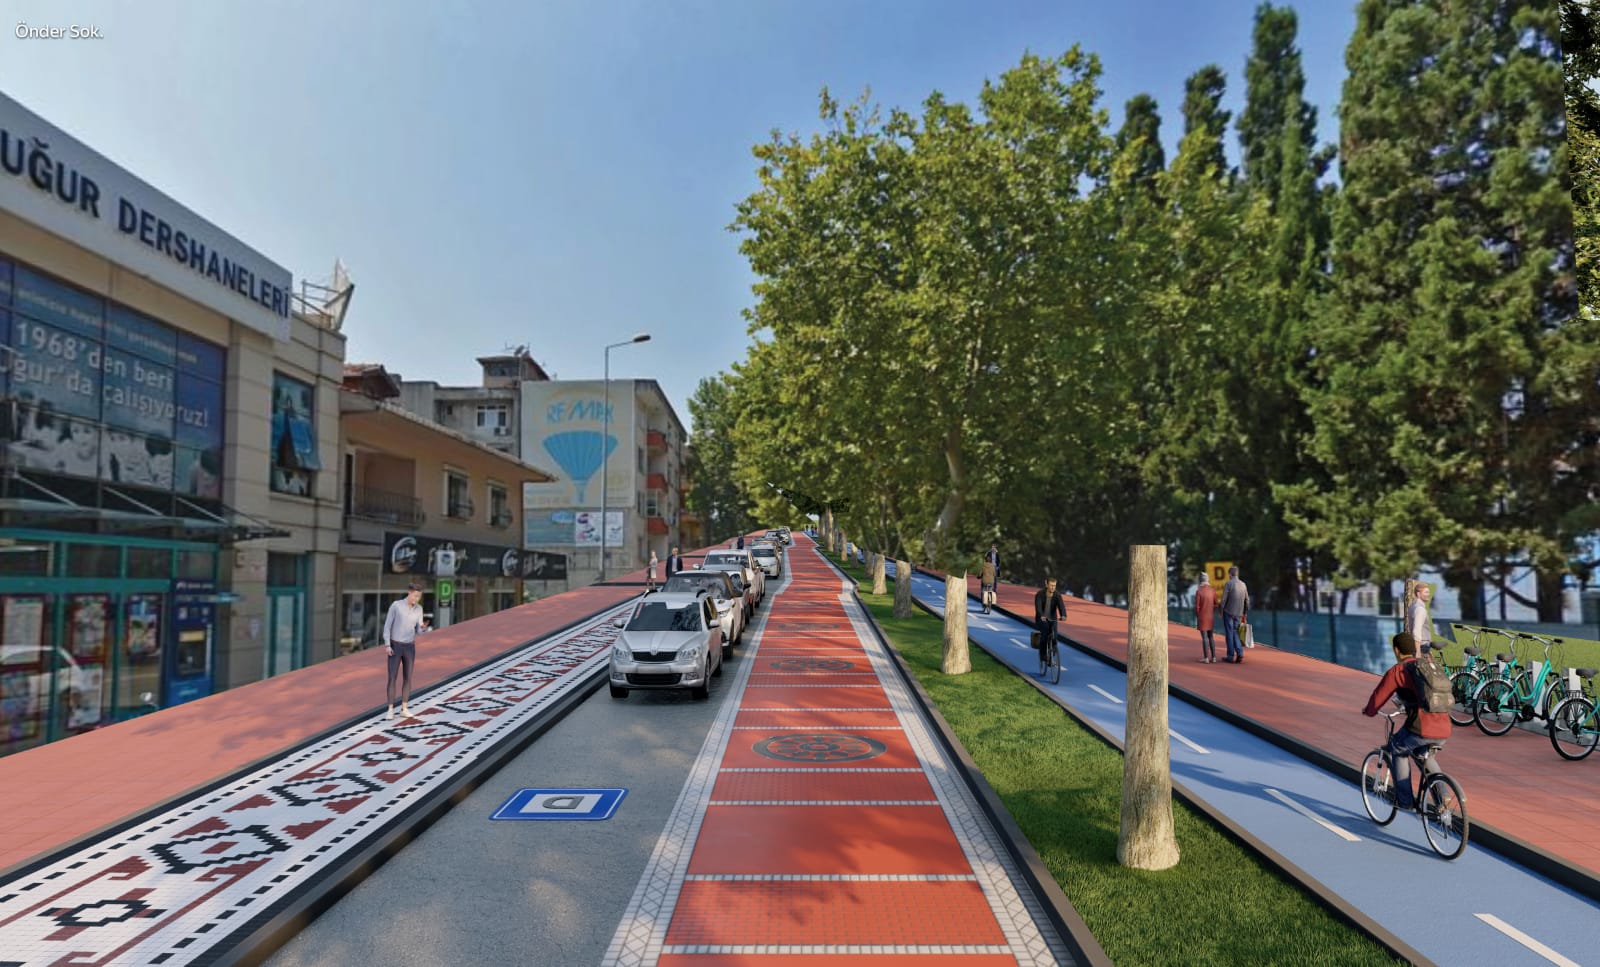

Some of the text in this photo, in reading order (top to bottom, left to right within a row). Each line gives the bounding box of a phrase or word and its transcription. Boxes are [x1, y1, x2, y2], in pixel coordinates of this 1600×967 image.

[0, 128, 290, 319] UĞUR DERSHANELERİ
[133, 359, 174, 391] beri
[1214, 566, 1225, 580] D
[441, 583, 451, 597] D
